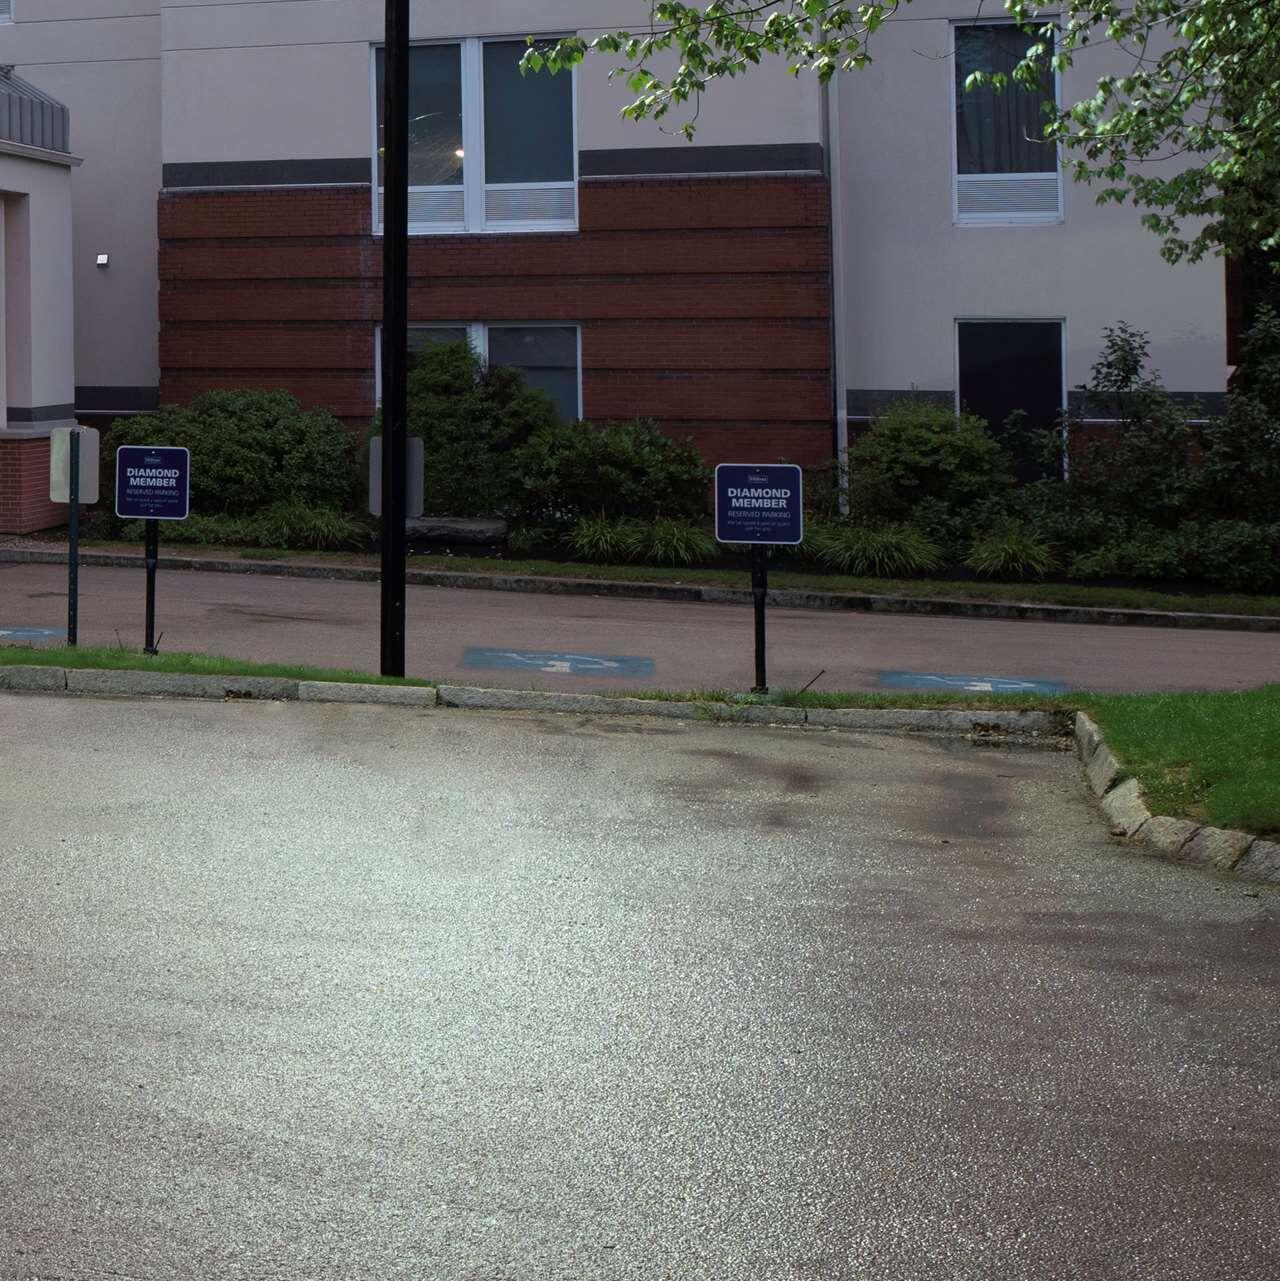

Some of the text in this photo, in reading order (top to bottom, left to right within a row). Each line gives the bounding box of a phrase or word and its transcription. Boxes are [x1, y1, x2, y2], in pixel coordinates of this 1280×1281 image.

[127, 468, 180, 478] DIAMOND
[129, 477, 177, 487] MEMBER
[727, 488, 791, 498] DIAMOND
[731, 498, 787, 508] MEMBER
